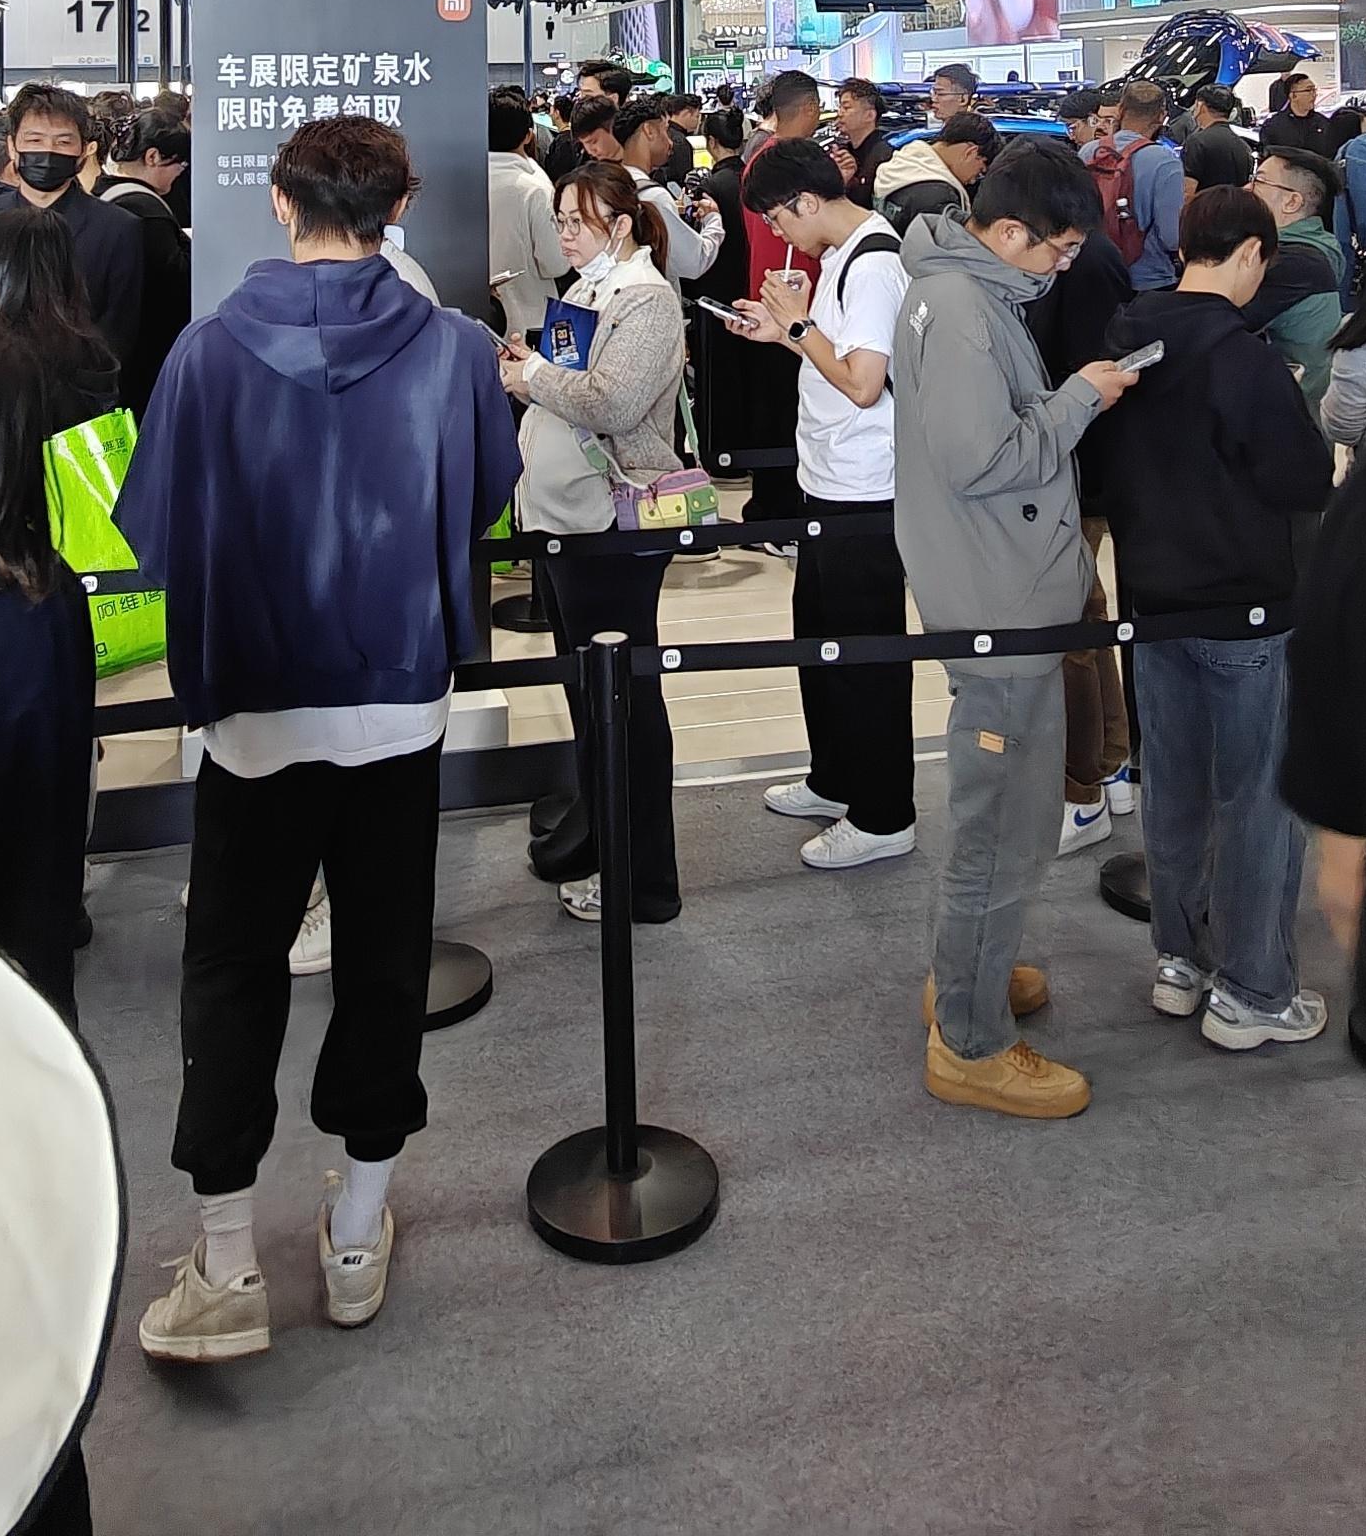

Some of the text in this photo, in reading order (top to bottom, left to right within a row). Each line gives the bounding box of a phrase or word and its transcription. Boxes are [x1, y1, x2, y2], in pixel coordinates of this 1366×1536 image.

[217, 51, 433, 89] 车展限定矿泉水
